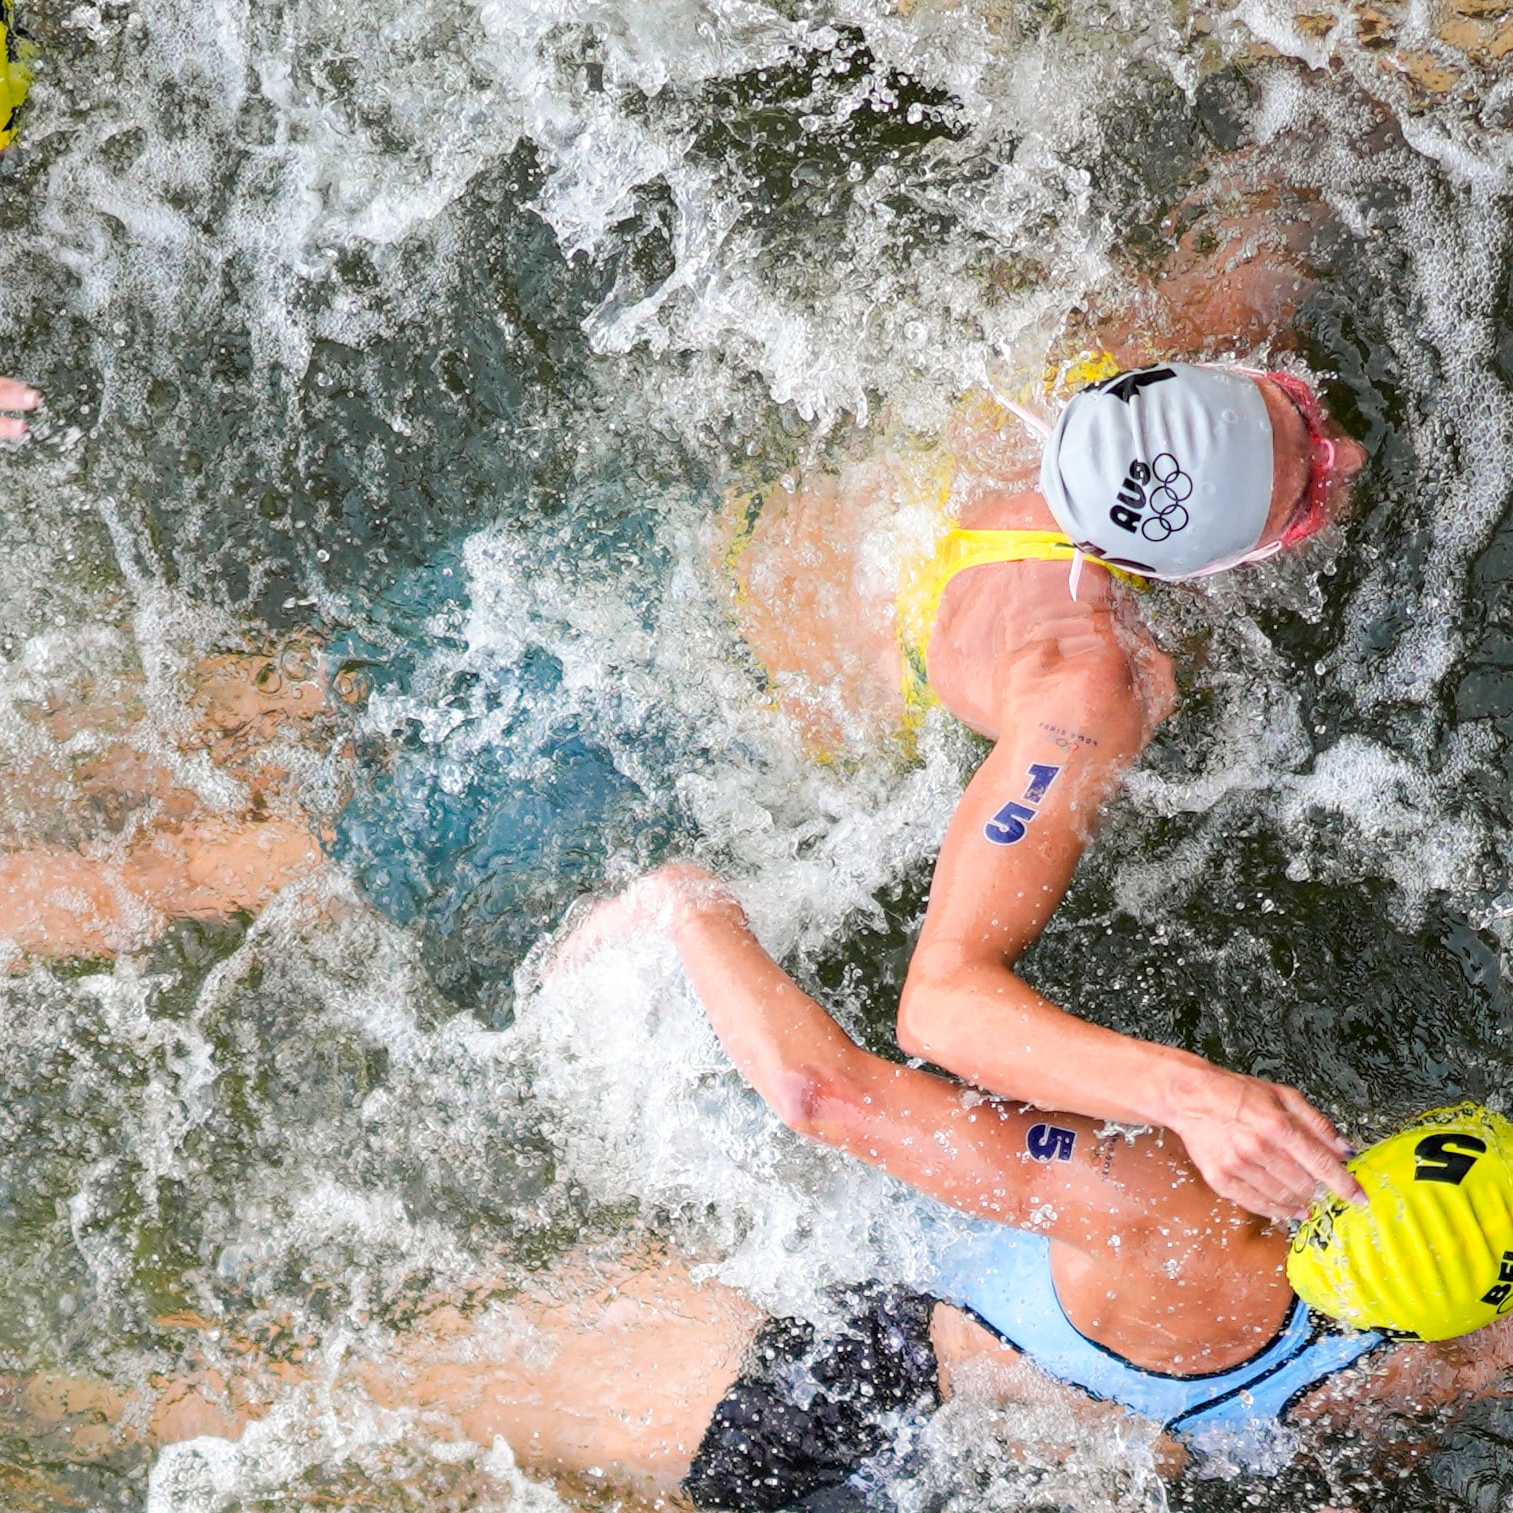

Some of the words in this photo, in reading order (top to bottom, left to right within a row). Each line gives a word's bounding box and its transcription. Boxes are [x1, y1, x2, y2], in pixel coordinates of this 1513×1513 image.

[1109, 458, 1151, 534] AUS
[983, 762, 1063, 847] 15
[1026, 1122, 1078, 1164] 5
[1413, 1133, 1487, 1186] 5
